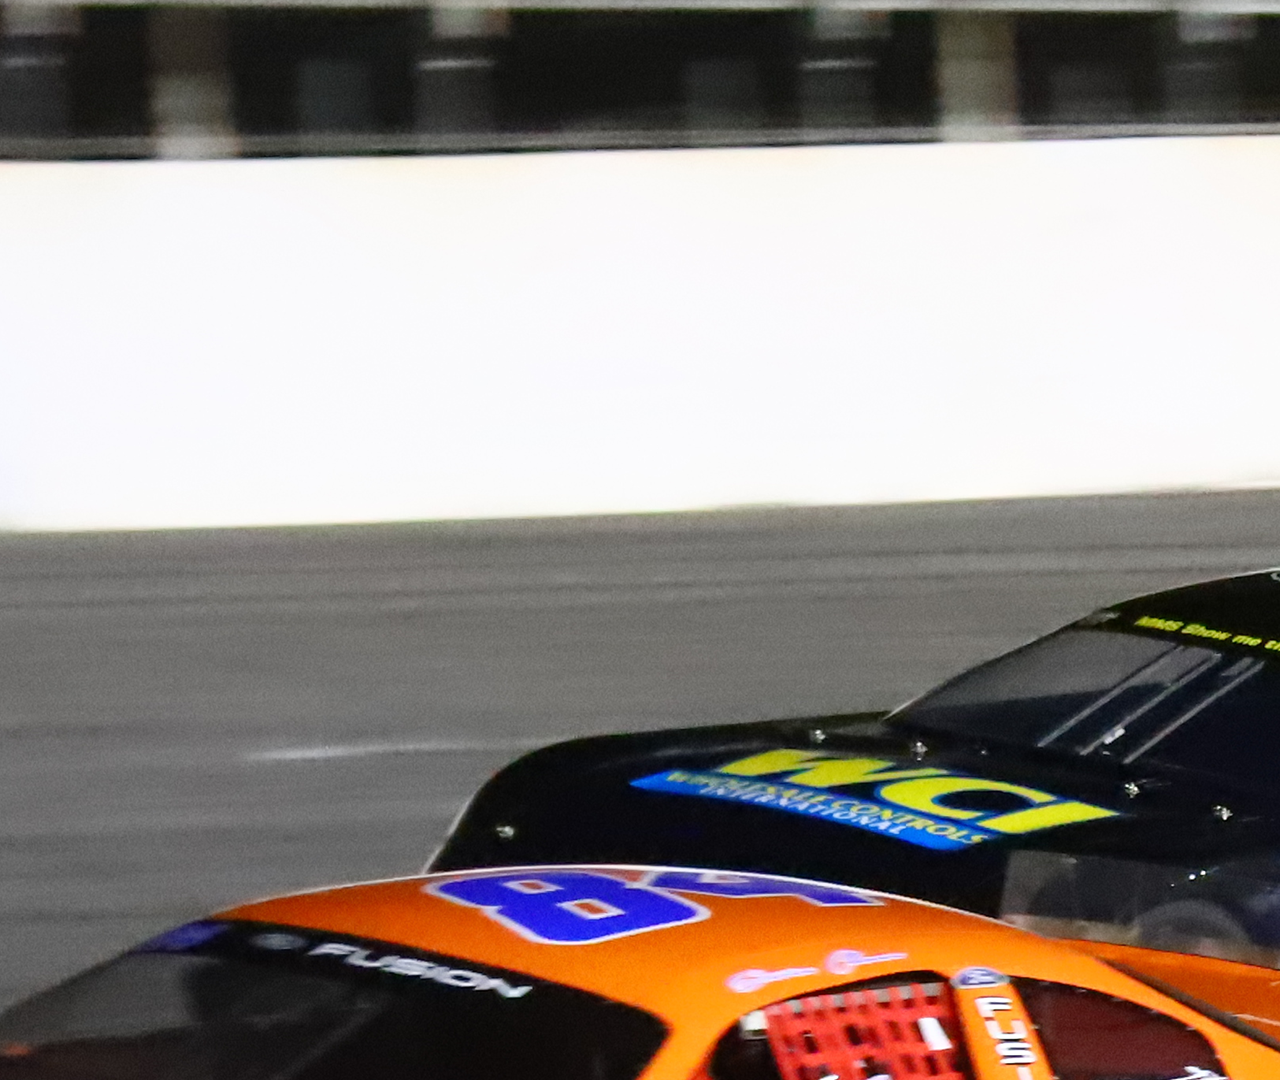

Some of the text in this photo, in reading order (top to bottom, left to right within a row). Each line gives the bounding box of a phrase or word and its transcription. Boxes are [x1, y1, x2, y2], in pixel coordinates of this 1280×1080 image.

[1181, 623, 1231, 641] Show
[1232, 634, 1261, 646] me
[719, 748, 1120, 834] WCI
[307, 943, 533, 999] FUSION
